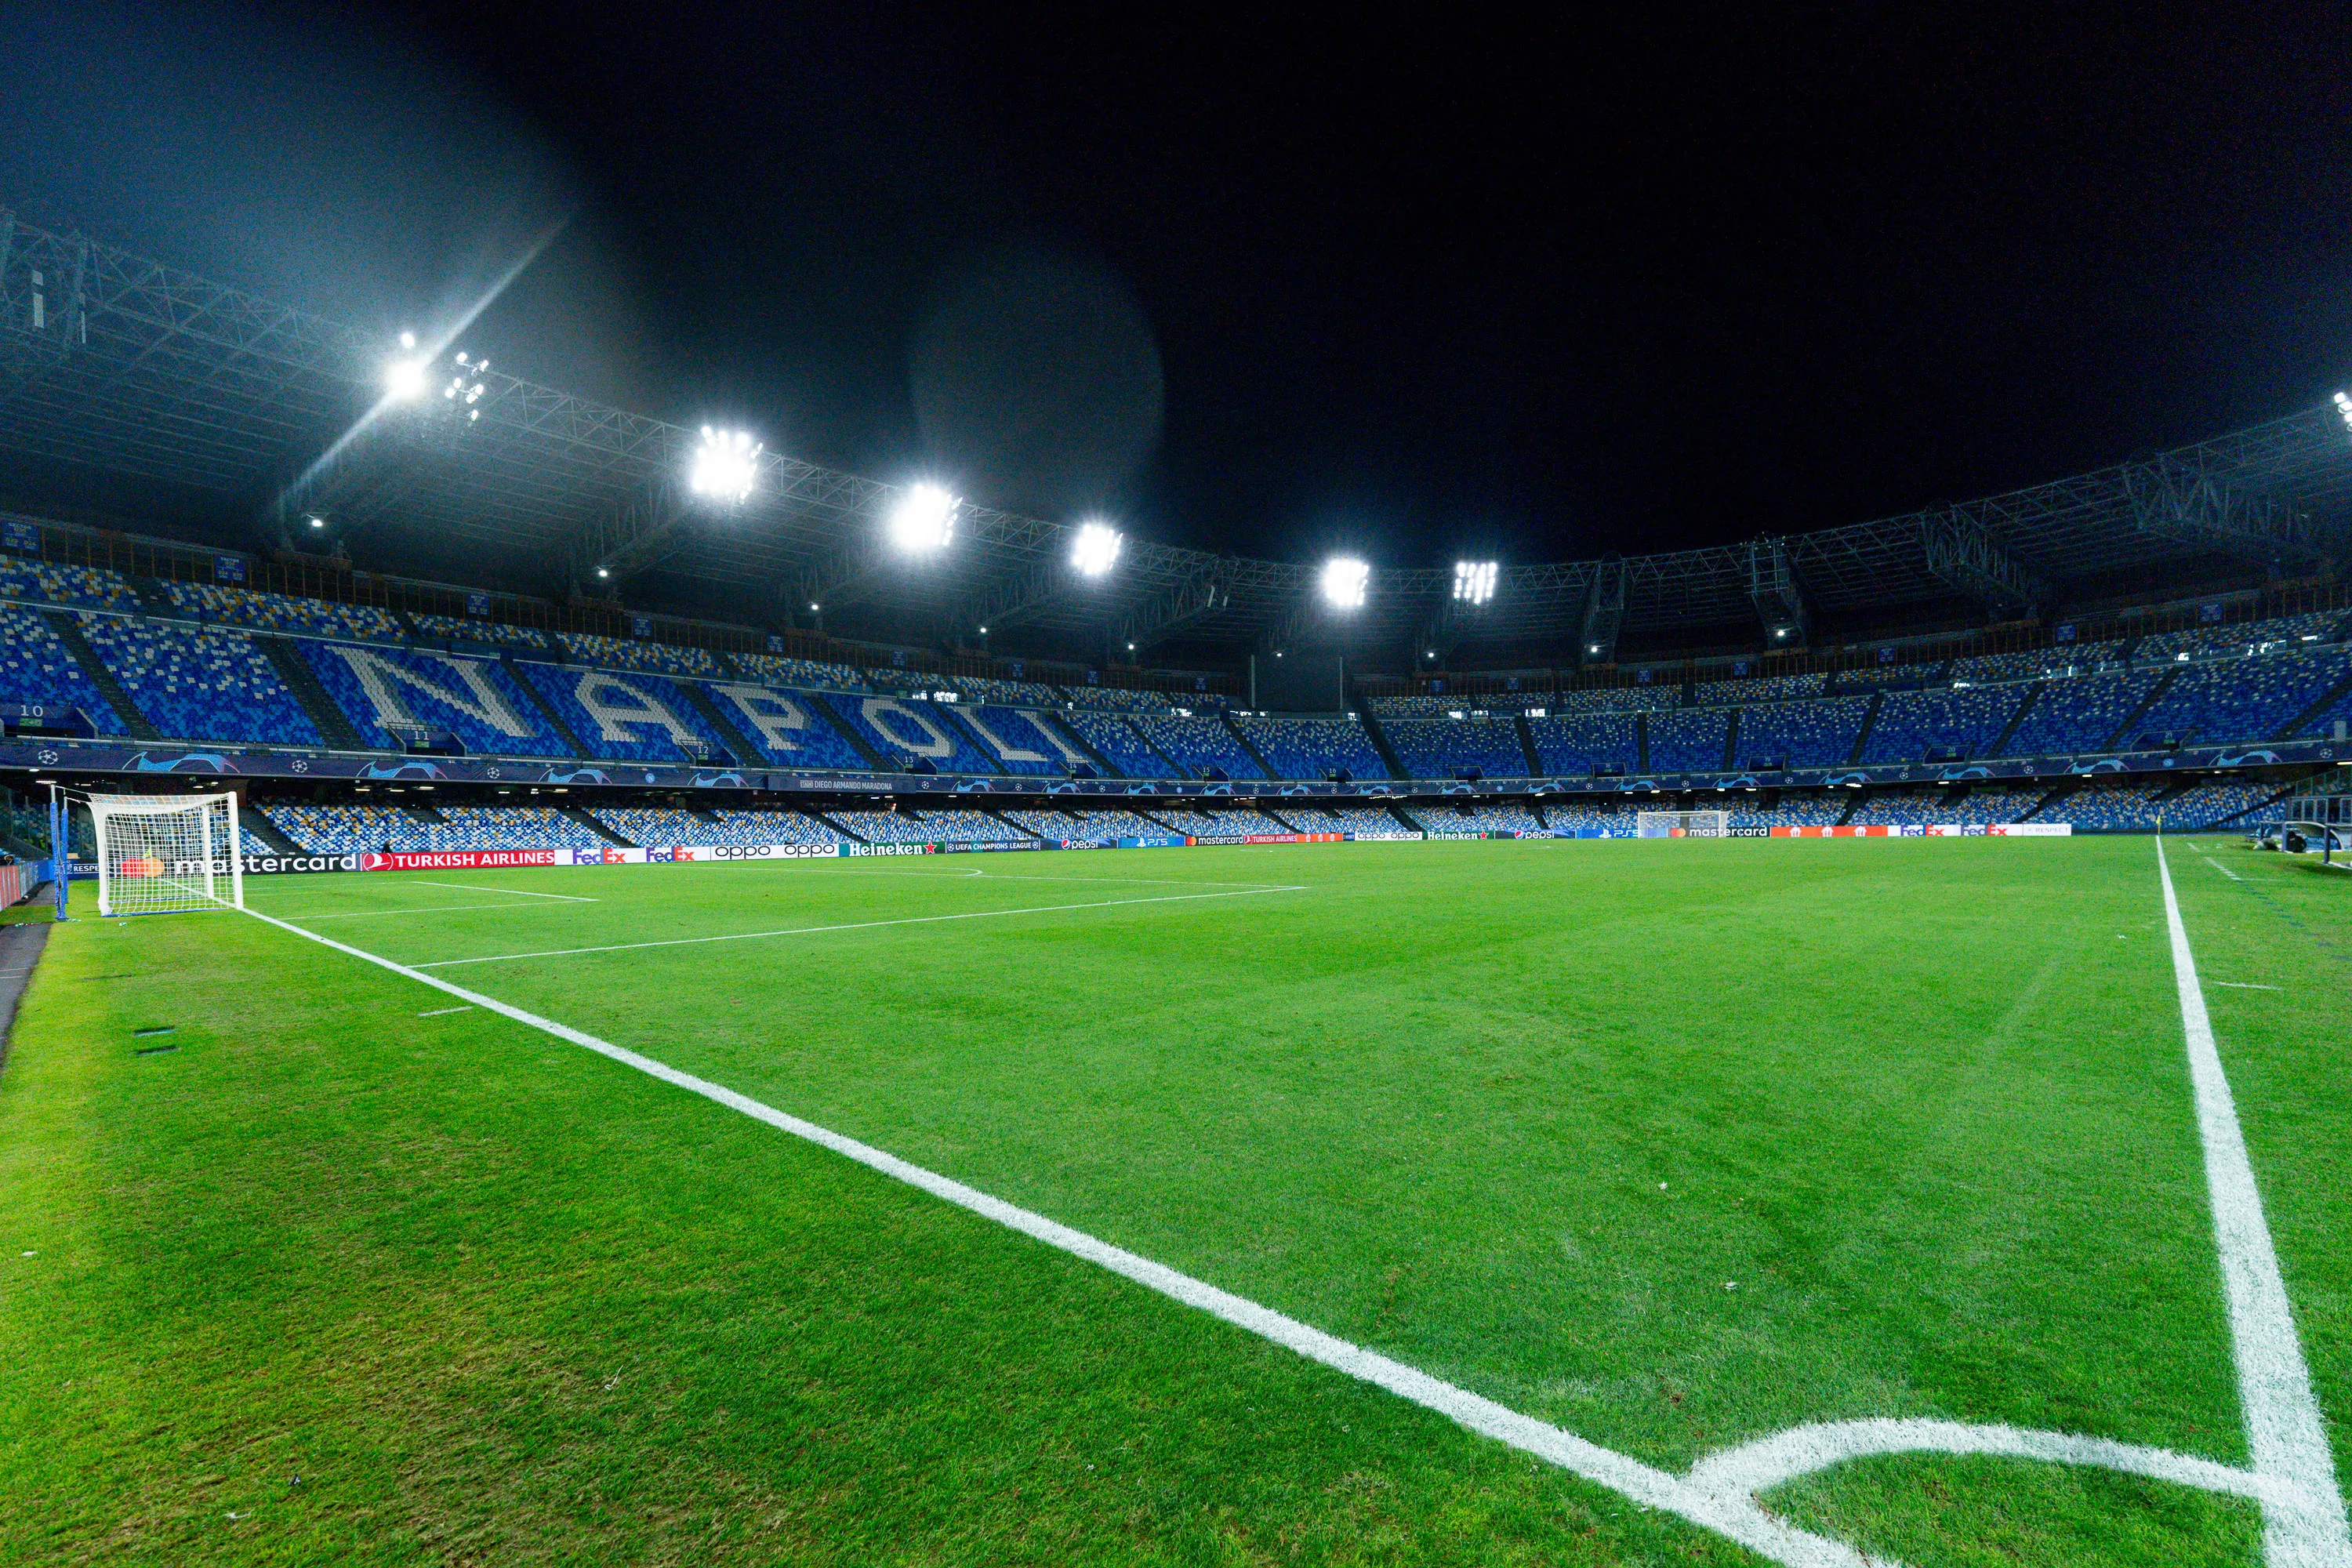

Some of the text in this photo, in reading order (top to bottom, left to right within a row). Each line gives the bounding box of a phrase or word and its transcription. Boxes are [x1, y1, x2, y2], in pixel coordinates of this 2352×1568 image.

[323, 645, 1094, 764] NAPOLI
[20, 705, 44, 717] 10
[414, 731, 430, 740] 11
[698, 746, 709, 754] 12
[833, 781, 861, 789] ARMANDO
[862, 782, 893, 791] MARADONA
[1358, 832, 1385, 840] oppo
[1391, 832, 1420, 840] oppo
[1427, 831, 1479, 840] Heineken
[1525, 829, 1555, 839] pepsi
[1900, 824, 1944, 837] FedEx
[1961, 824, 2007, 837] FedEx
[1072, 838, 1098, 850] pepsi
[1199, 835, 1243, 845] mastercard
[715, 845, 771, 859] oppo
[784, 844, 835, 858] oppo
[849, 842, 924, 856] Heineken
[973, 842, 1008, 851] CHAMPIONS
[395, 851, 554, 868] TURKISH AIRLINES
[572, 848, 626, 865] FedEx
[646, 847, 695, 862] FedEx
